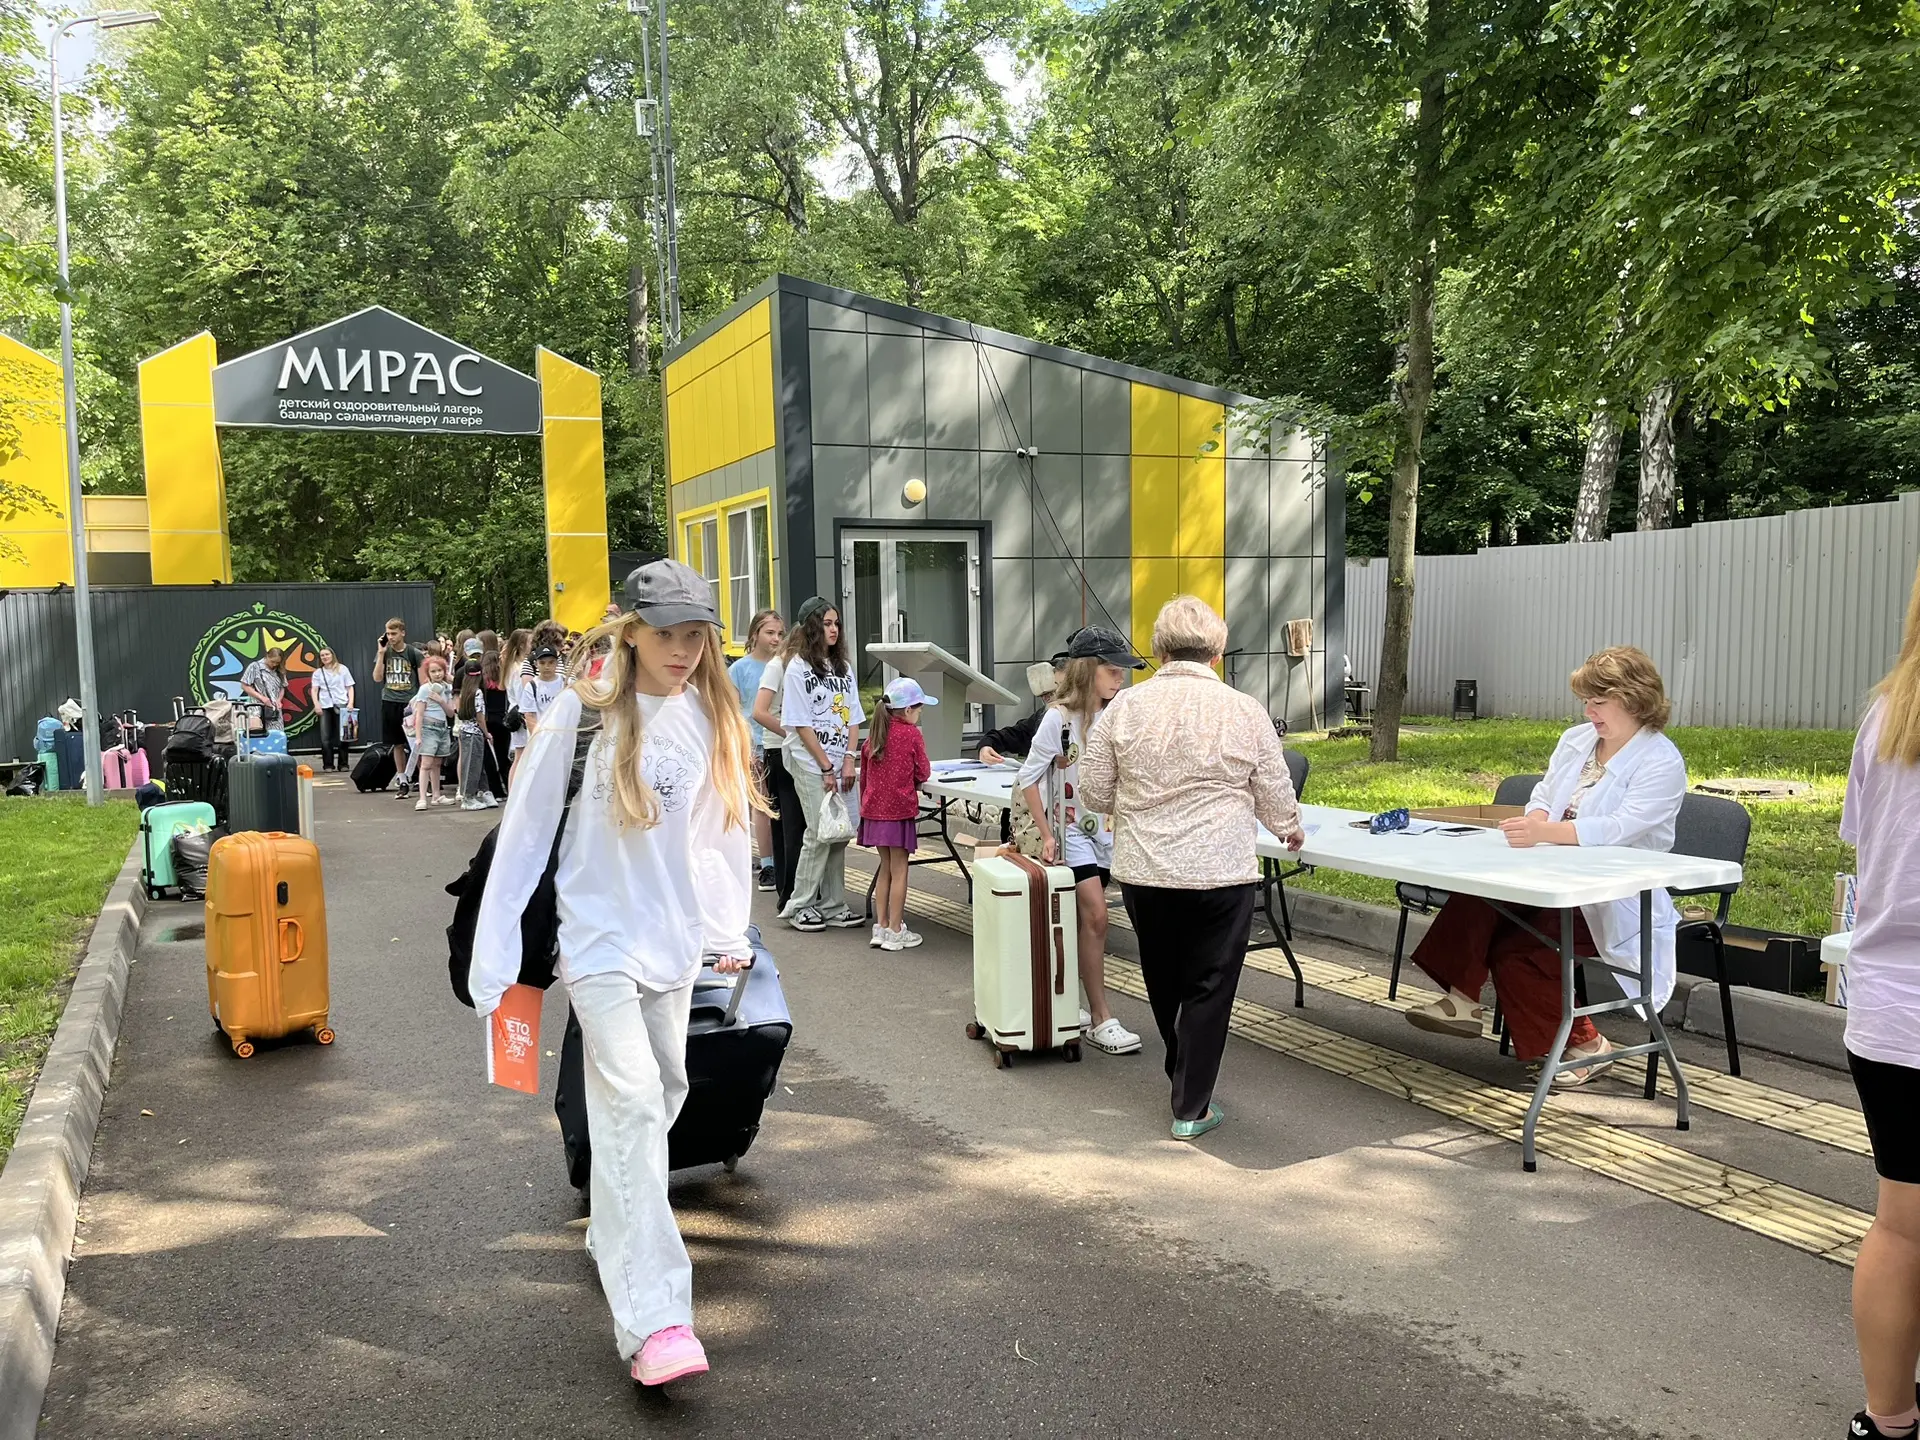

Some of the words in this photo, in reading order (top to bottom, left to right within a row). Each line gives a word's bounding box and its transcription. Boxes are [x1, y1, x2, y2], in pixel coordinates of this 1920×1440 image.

[277, 346, 483, 396] МИРАС
[279, 398, 330, 409] детский
[333, 400, 440, 413] оздоровительный
[443, 405, 483, 415] лагерь
[280, 409, 332, 422] балалар
[442, 417, 483, 427] лагере
[386, 659, 412, 673] RUN
[386, 673, 411, 684] WALK
[654, 735, 674, 750] my
